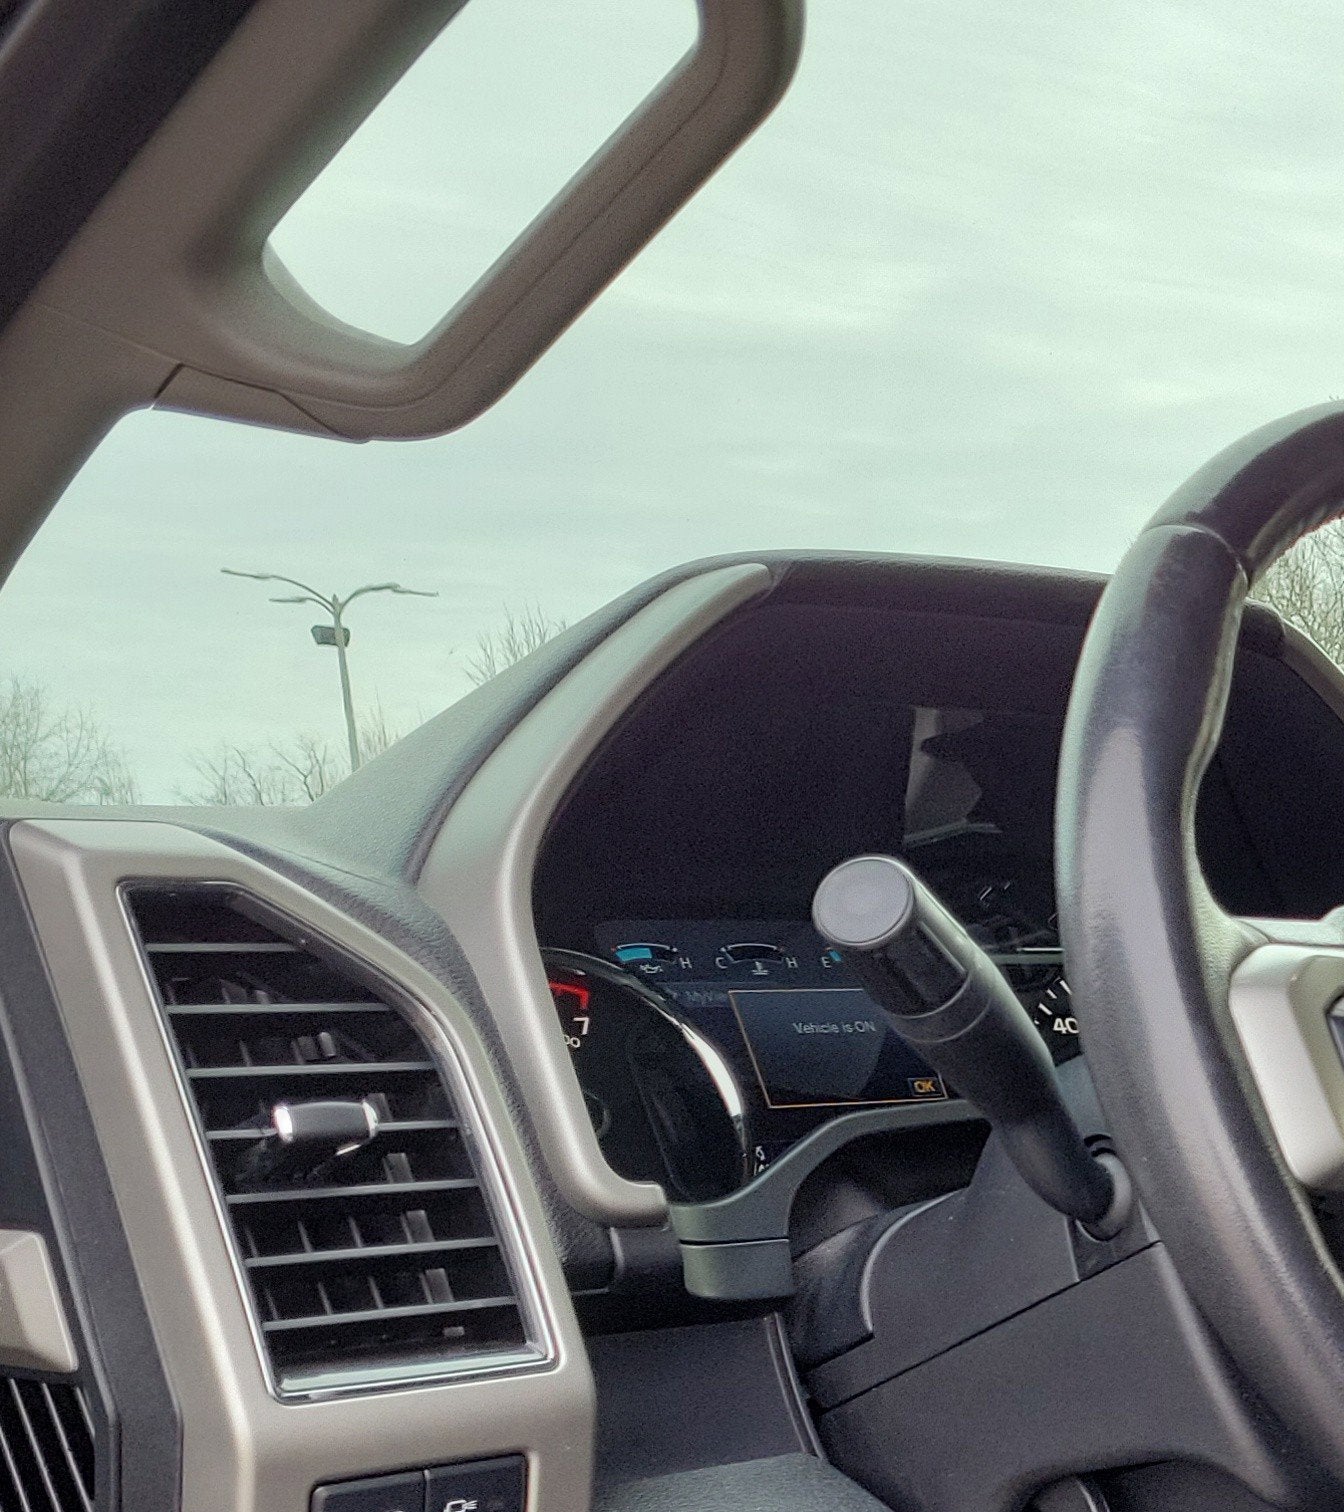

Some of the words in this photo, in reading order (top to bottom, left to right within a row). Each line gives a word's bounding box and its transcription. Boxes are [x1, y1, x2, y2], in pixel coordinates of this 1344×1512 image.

[821, 957, 833, 969] E
[572, 1017, 590, 1035] 7
[792, 1022, 839, 1035] Vehicle
[842, 1021, 854, 1033] is
[854, 1020, 877, 1033] ON
[913, 1079, 936, 1094] OK
